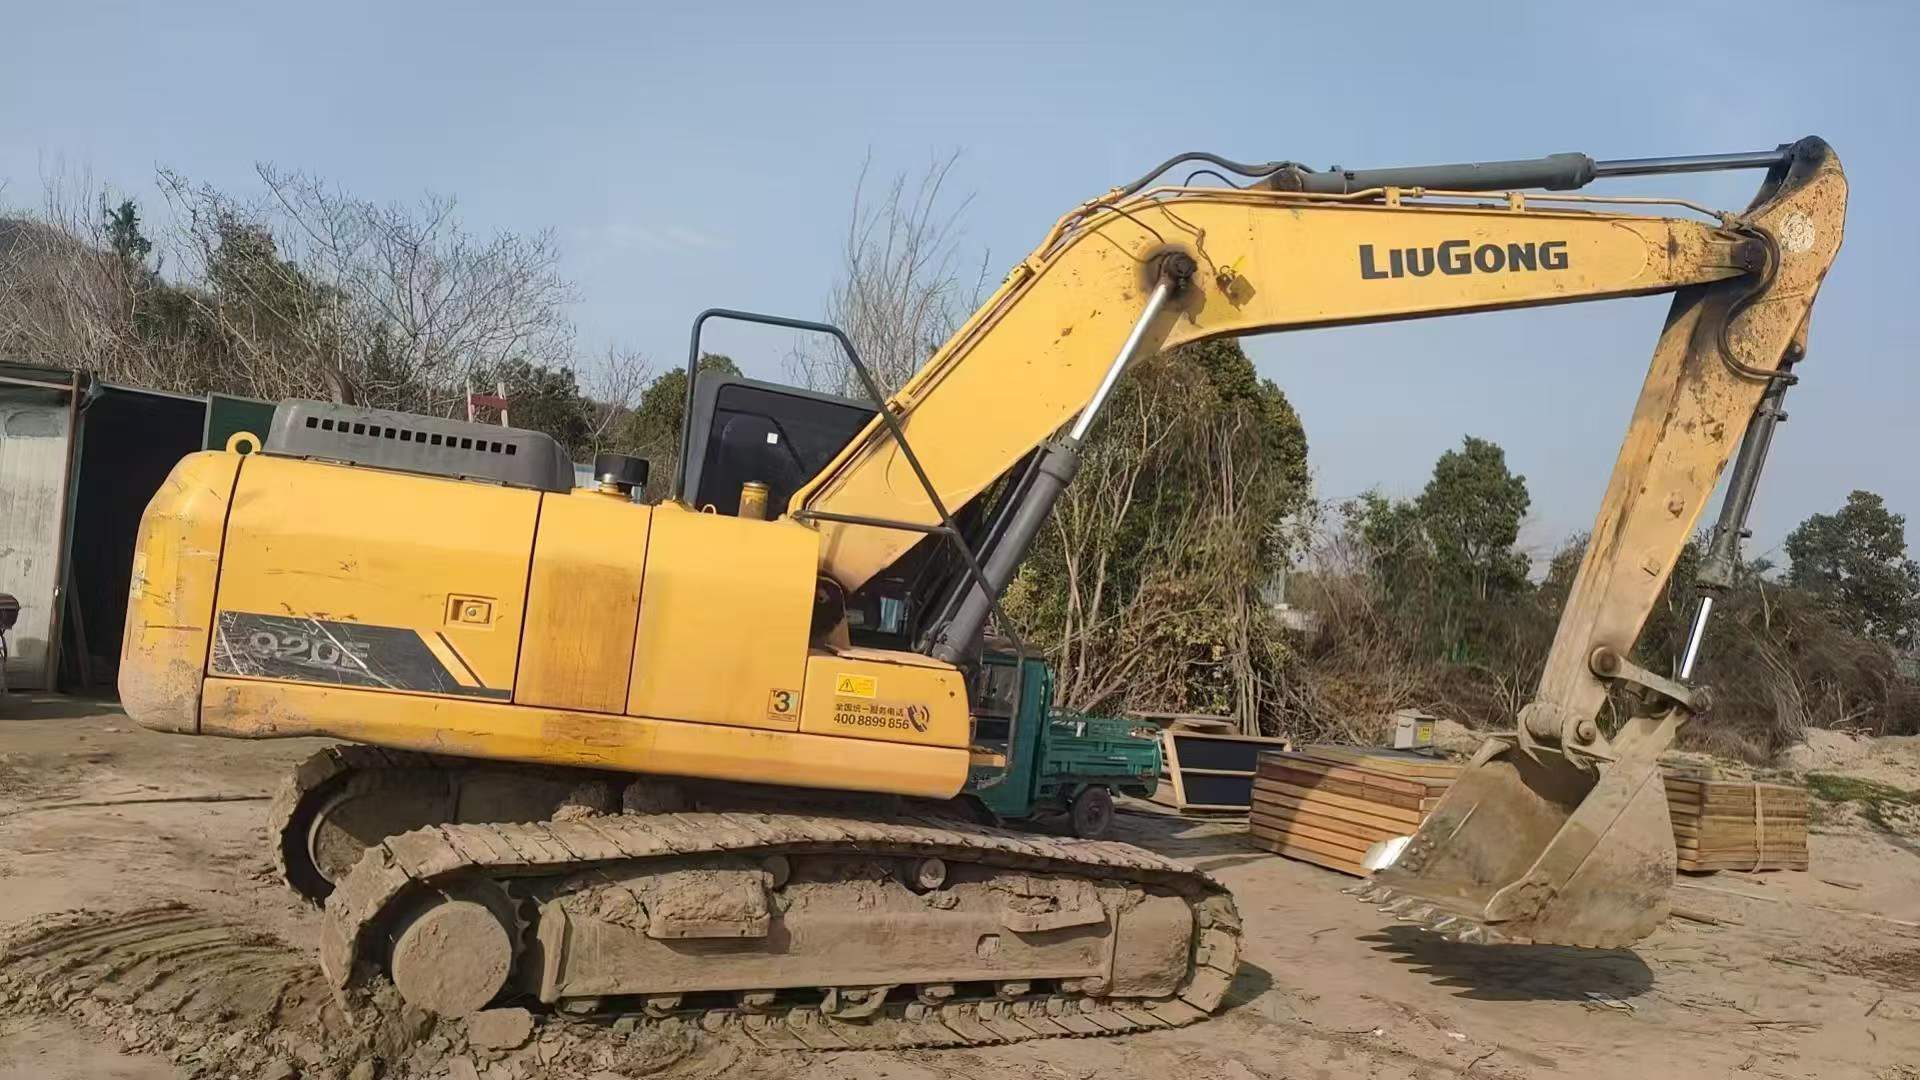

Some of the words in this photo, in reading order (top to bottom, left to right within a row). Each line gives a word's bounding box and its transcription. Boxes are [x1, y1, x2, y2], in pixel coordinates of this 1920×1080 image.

[836, 703, 904, 717] 全国统一服务电话
[834, 713, 856, 724] 400
[857, 715, 886, 728] 8899
[888, 718, 910, 730] 856
